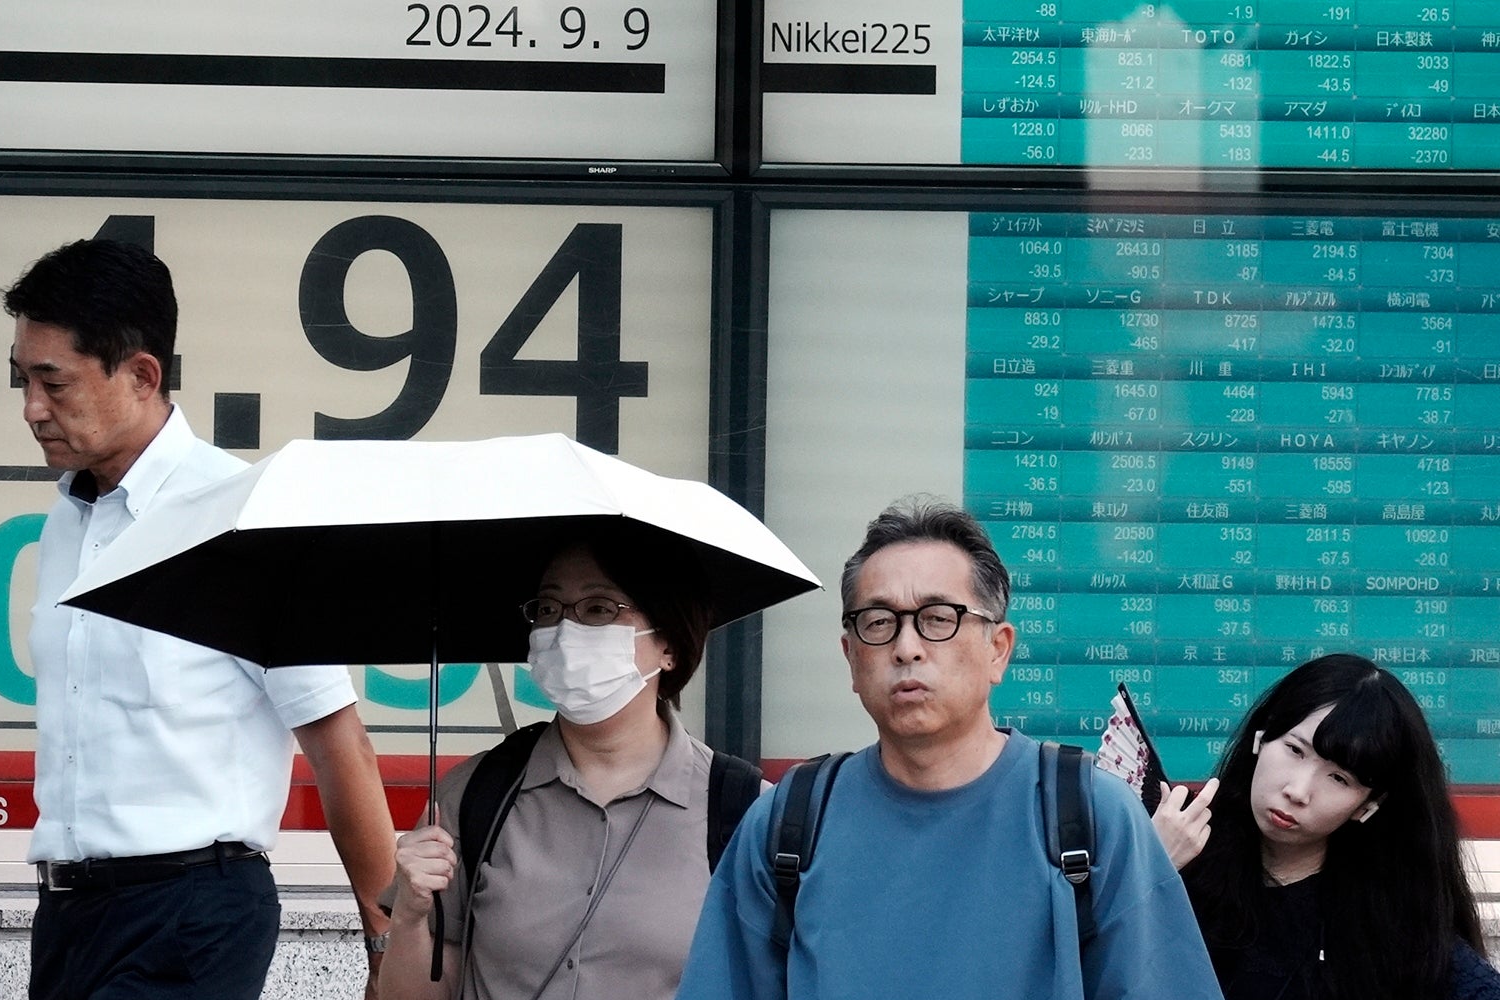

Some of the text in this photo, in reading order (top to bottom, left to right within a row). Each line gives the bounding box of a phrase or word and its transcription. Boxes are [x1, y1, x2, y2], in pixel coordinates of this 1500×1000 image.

[1036, 3, 1057, 18] -88
[1141, 3, 1155, 18] -8
[1228, 6, 1254, 20] -1.9
[1323, 7, 1351, 21] -191
[1417, 8, 1450, 22] -26.5
[406, 4, 650, 51] 2024. 9. 9
[771, 22, 931, 55] Nikkei225
[1285, 31, 1328, 46] ガイシ
[1377, 31, 1433, 47] 日本製鉄
[1012, 51, 1057, 65] 2954.5
[1118, 52, 1153, 67] 825.1
[1220, 52, 1252, 68] 4681
[1308, 54, 1351, 69] 1822.5
[1418, 56, 1450, 70] 3033
[1015, 75, 1056, 89] -124.5
[1121, 76, 1155, 91] -21.2
[1224, 77, 1253, 92] -132
[1318, 78, 1352, 93] -43.5
[1429, 80, 1449, 93] -49
[984, 98, 1040, 114] しずおか
[1179, 100, 1237, 117] オークマ
[1285, 101, 1328, 117] アマダ
[1012, 122, 1056, 137] 1228.0
[1121, 123, 1154, 138] 8066
[1220, 124, 1252, 139] 5433
[1307, 126, 1351, 140] 1411.0
[1409, 126, 1448, 141] 32280
[1022, 146, 1055, 160] -56.0
[1125, 146, 1154, 161] -233
[1222, 147, 1252, 162] -183
[1317, 149, 1350, 163] -44.5
[1411, 150, 1448, 164] -2370
[1292, 220, 1335, 237] 三菱電
[1382, 220, 1440, 238] 富士電機
[1020, 241, 1063, 255] 1064.0
[1116, 240, 1161, 257] 2643.0
[1226, 243, 1259, 259] 3185
[1313, 245, 1358, 259] 2194.5
[1424, 246, 1455, 260] 7304
[1029, 264, 1062, 279] -39.5
[1127, 265, 1161, 280] -90.5
[1237, 266, 1259, 281] -87
[1324, 268, 1357, 282] -84.5
[1426, 269, 1455, 284] -373
[989, 286, 1046, 304] シャープ
[1087, 289, 1142, 305] ソニーG
[1387, 292, 1431, 309] 横河電
[1024, 312, 1061, 326] 883.0
[1120, 313, 1160, 328] 12730
[1225, 311, 1258, 329] 8725
[1313, 314, 1356, 330] 1473.5
[1422, 316, 1453, 331] 3564
[1028, 335, 1061, 350] -29.2
[1129, 336, 1159, 351] -465
[1228, 337, 1257, 352] -417
[1322, 338, 1355, 353] -32.0
[1432, 340, 1451, 354] -91
[994, 358, 1036, 375] 日立造
[1092, 359, 1135, 376] 三菱重
[1035, 383, 1059, 398] 924
[1114, 384, 1158, 399] 1645.0
[1223, 385, 1256, 400] 4464
[1322, 386, 1354, 401] 5943
[1416, 387, 1453, 402] 778.5
[1037, 406, 1060, 421] -19
[1124, 407, 1158, 422] -67.0
[1226, 408, 1256, 424] -228
[1418, 410, 1452, 425] -38.7
[991, 431, 1035, 446] ニコン
[1181, 432, 1239, 448] スクリン
[1015, 454, 1058, 469] 1421.0
[1112, 455, 1157, 470] 2506.5
[1222, 456, 1255, 470] 9149
[1313, 457, 1353, 472] 18555
[1418, 458, 1452, 473] 4718
[1025, 477, 1058, 492] -36.5
[1122, 478, 1157, 493] -23.0
[1225, 479, 1252, 494] -551
[1322, 480, 1352, 495] -595
[1421, 481, 1451, 496] -123
[990, 500, 1034, 517] 三井物
[1186, 502, 1230, 519] 住友商
[1286, 503, 1328, 520] 三菱商
[1383, 503, 1426, 521] 高島屋
[1012, 525, 1057, 540] 2784.5
[1113, 526, 1155, 541] 20580
[1220, 527, 1253, 542] 3153
[1306, 527, 1352, 543] 2811.5
[1405, 529, 1449, 544] 1092.0
[1022, 549, 1056, 563] -94.0
[1117, 549, 1155, 565] -1420
[1231, 550, 1253, 565] -92
[1317, 551, 1351, 566] -67.5
[1415, 552, 1449, 567] -28.0
[1366, 576, 1440, 591] SOMPOHD
[1011, 597, 1055, 611] 2788.0
[1121, 595, 1153, 612] 3323
[1214, 598, 1252, 614] 990.5
[1314, 598, 1352, 614] 766.3
[1415, 599, 1448, 615] 3190
[1124, 621, 1153, 636] -106
[1217, 621, 1252, 637] -37.5
[1315, 621, 1352, 638] -35.6
[1418, 623, 1446, 638] -121
[1085, 643, 1129, 661] 小田急
[1371, 647, 1431, 663] JR東日本
[1011, 668, 1055, 683] 1839.0
[1109, 669, 1152, 682] 1689.0
[1218, 669, 1251, 684] 3521
[1402, 671, 1447, 685] 2815.0
[1021, 691, 1054, 706] -19.5
[1229, 693, 1249, 705] -51
